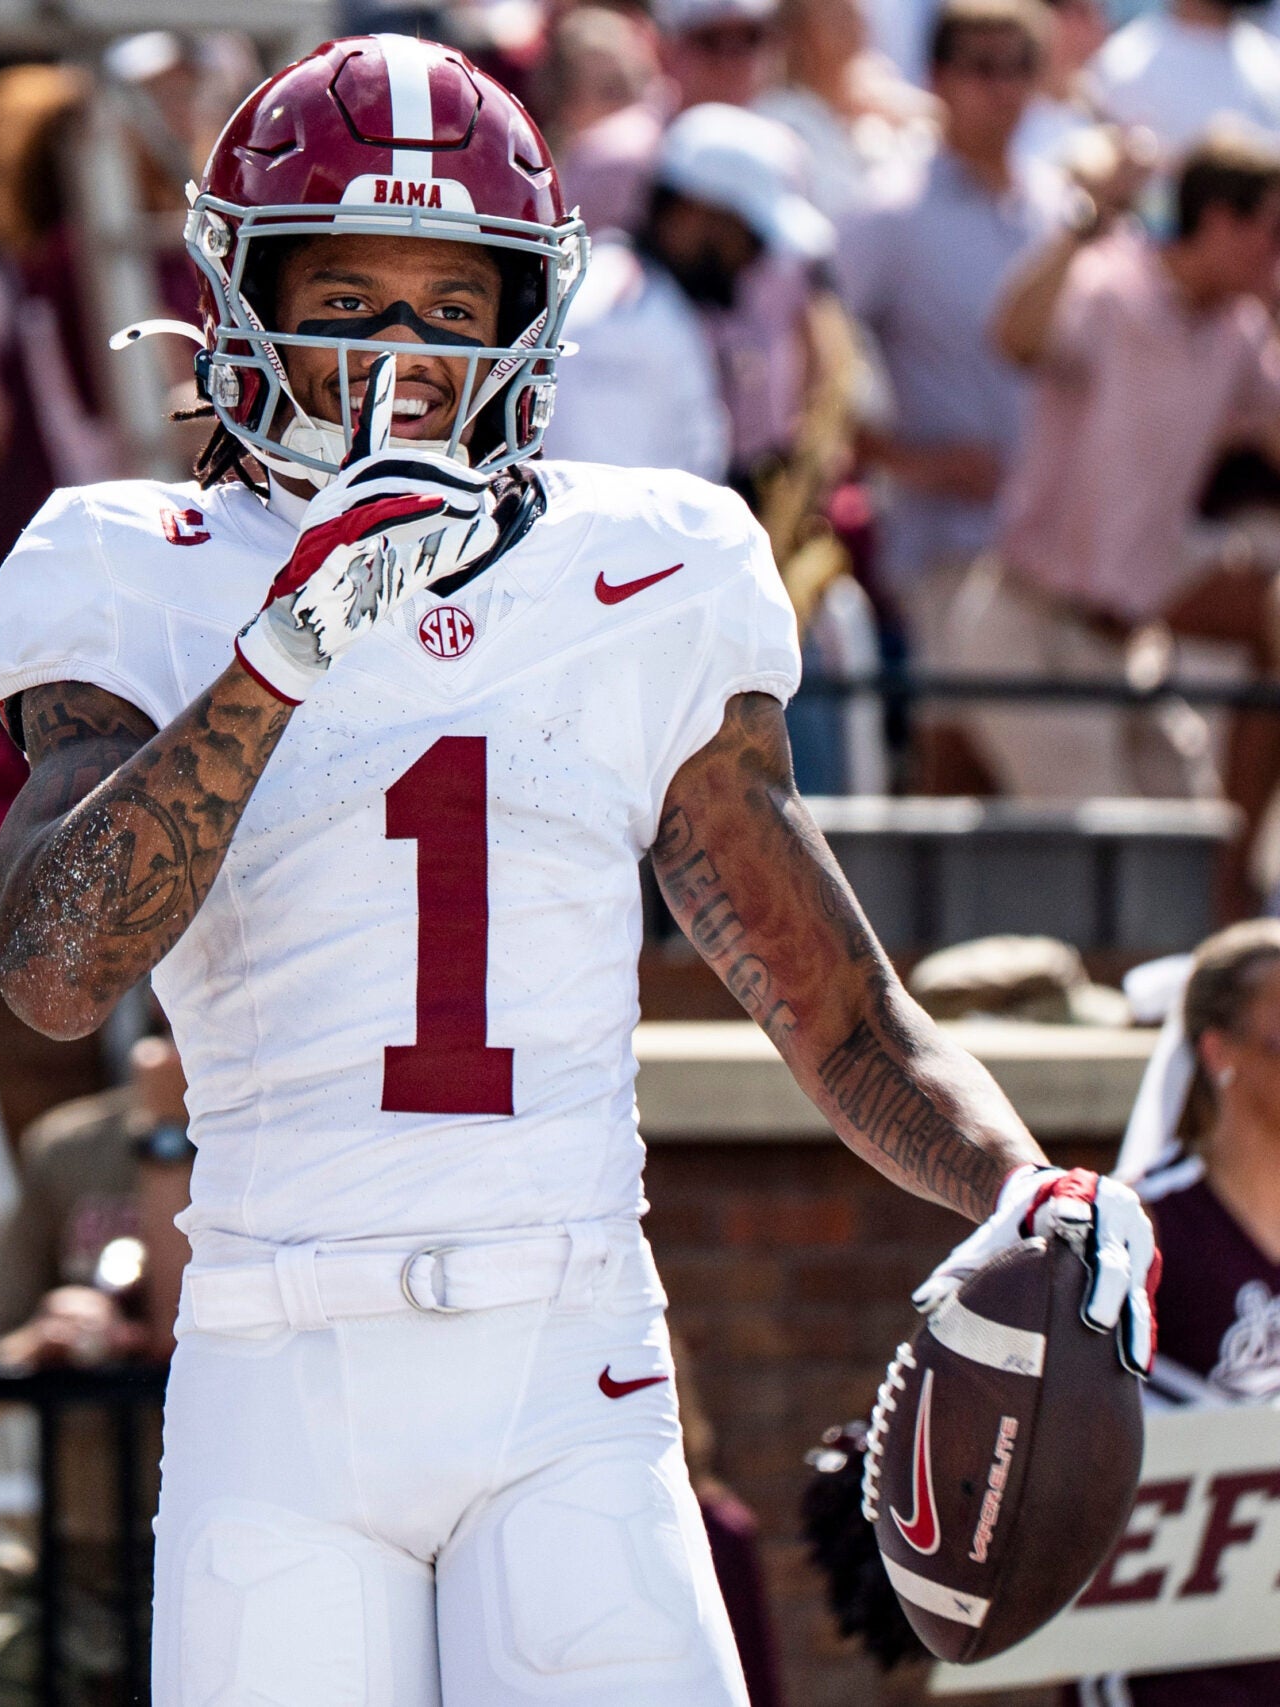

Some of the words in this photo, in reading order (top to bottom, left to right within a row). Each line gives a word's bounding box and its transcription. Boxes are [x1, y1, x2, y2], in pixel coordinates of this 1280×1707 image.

[374, 180, 442, 208] BAMA
[160, 508, 212, 546] C
[420, 608, 473, 657] SEC
[381, 736, 514, 1115] 1
[969, 1489, 1003, 1564] VAPOR
[988, 1415, 1019, 1491] ELITE
[1074, 1467, 1280, 1609] EF
